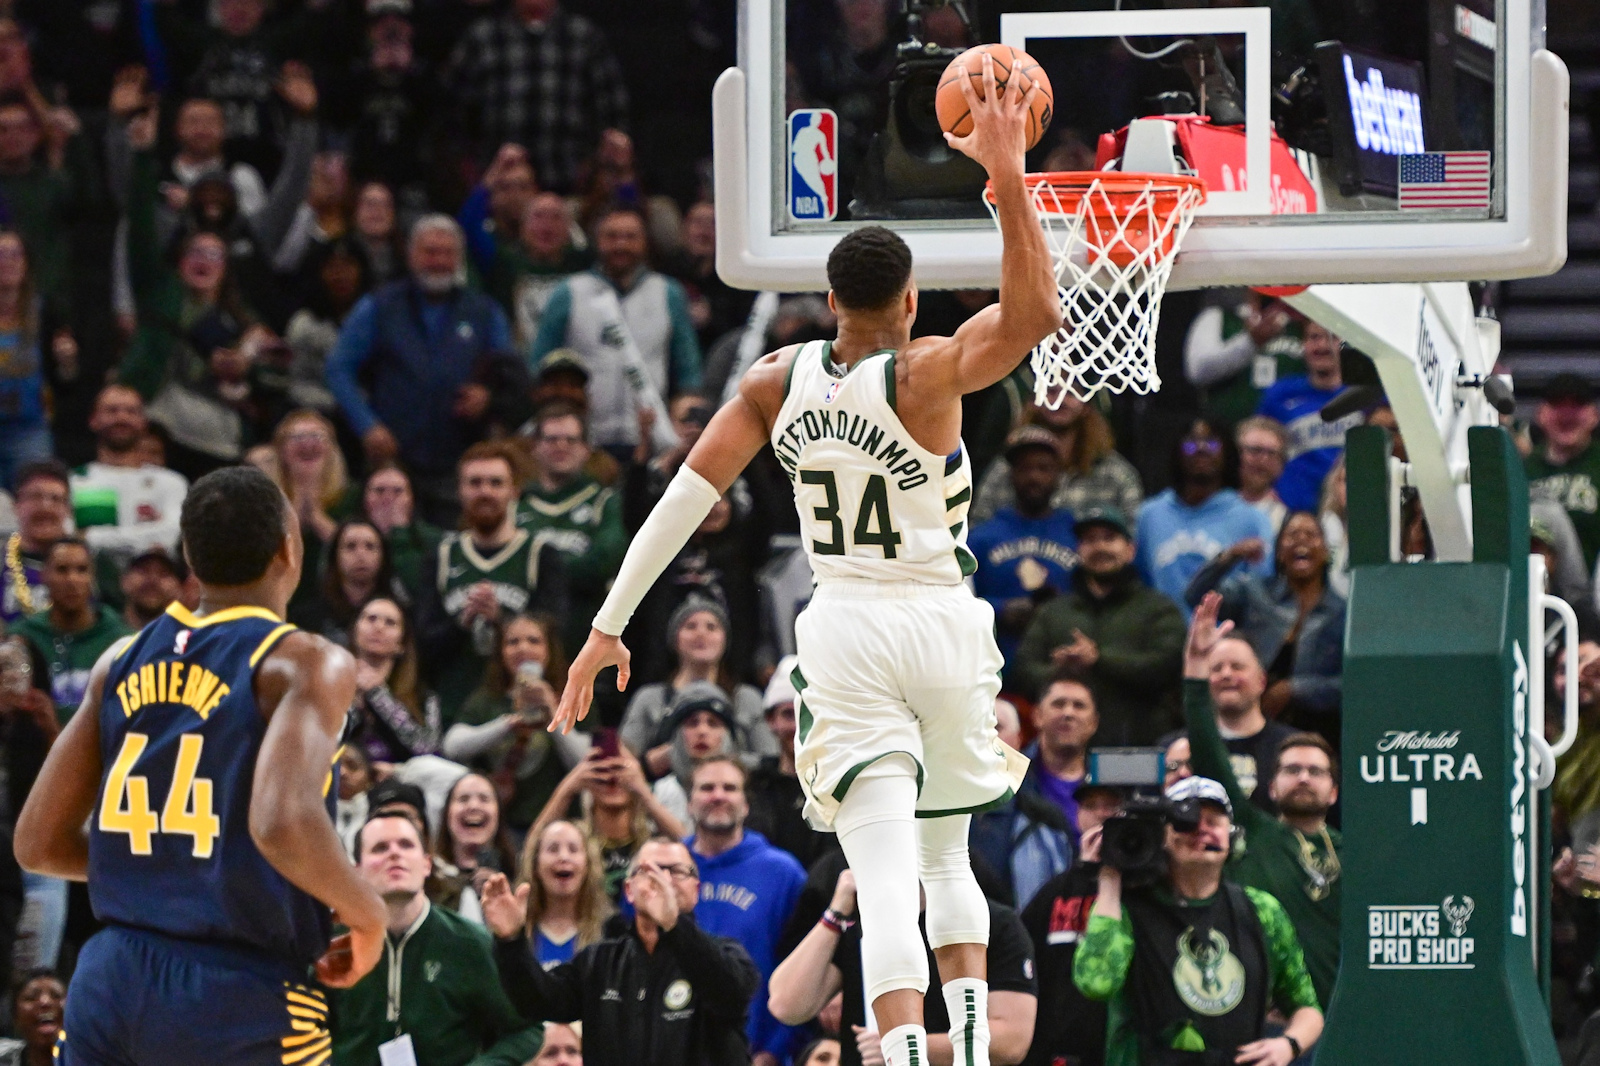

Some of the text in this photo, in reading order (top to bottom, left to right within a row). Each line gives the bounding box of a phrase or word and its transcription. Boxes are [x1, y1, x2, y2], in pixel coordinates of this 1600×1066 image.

[795, 196, 819, 215] NBA
[800, 469, 902, 559] 34
[1376, 730, 1461, 751] Michelob
[1360, 753, 1483, 782] ULTRA
[99, 732, 220, 859] 44
[1510, 639, 1528, 937] betway
[1369, 911, 1440, 937] BUCKS
[1369, 938, 1475, 964] PRO SHOP
